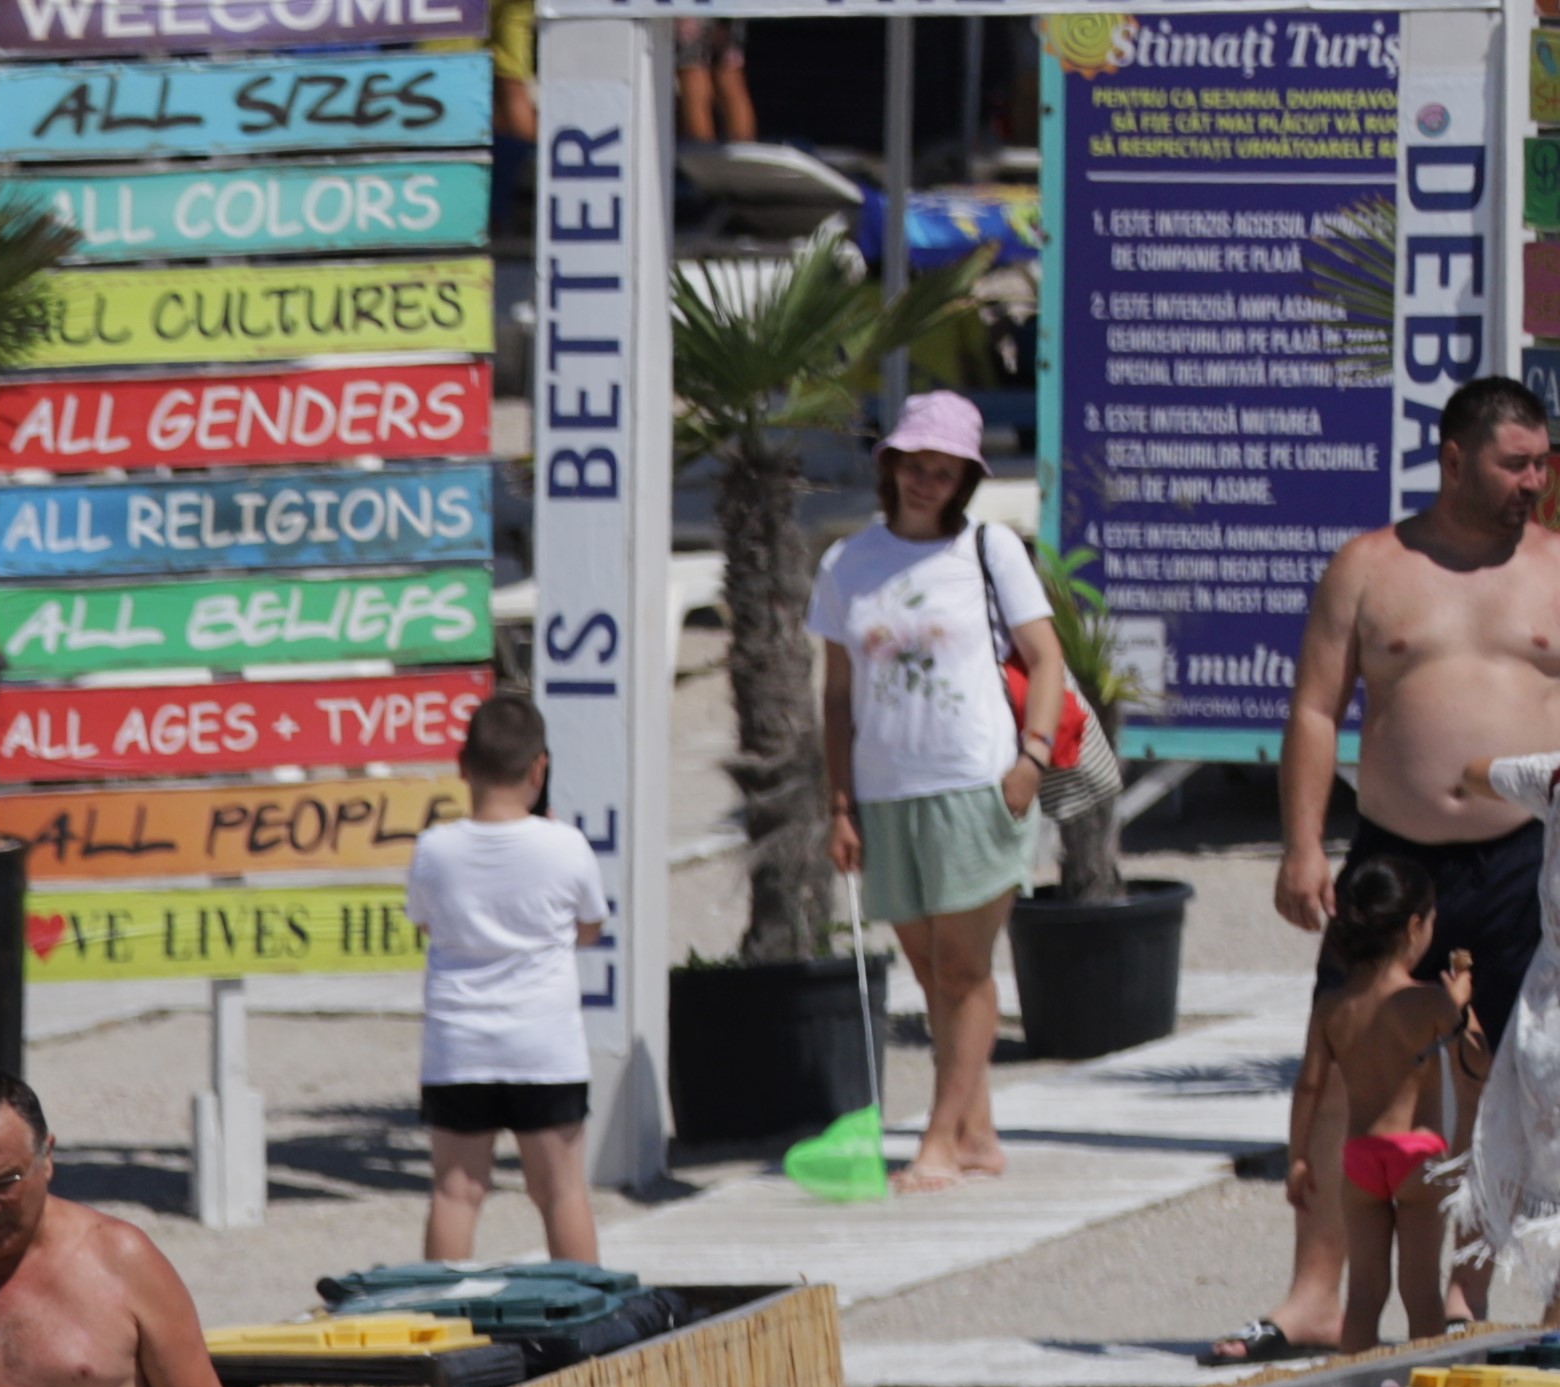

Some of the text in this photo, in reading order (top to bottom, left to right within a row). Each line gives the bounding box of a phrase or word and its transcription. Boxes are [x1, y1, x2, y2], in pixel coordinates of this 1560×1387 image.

[18, 0, 463, 41] WELCOME
[33, 71, 446, 138] ALL SIZES
[1091, 87, 1168, 109] PENTRU
[1170, 87, 1198, 109] CA
[1286, 88, 1398, 110] DUMNEAVO
[1215, 112, 1255, 133] MAI
[175, 174, 442, 240] COLORS
[1110, 210, 1154, 237] ESTE
[1156, 210, 1231, 237] INTERZIS
[1232, 211, 1310, 238] ACCESUL
[1137, 243, 1223, 272] COMPANIE
[1224, 244, 1250, 272] PE
[151, 281, 466, 342] CULTURES
[548, 123, 622, 500] BETTER
[1110, 291, 1152, 320] ESTE
[1153, 290, 1237, 321] INTERZISĂ
[1106, 357, 1172, 385] SPECIAL
[1174, 356, 1267, 386] DELIMITATĂ
[1269, 358, 1334, 387] PENTRU
[11, 380, 466, 455] ALL GENDERS
[1105, 403, 1149, 434] ESTE
[1150, 402, 1238, 435] INTERZISĂ
[1239, 406, 1323, 436] MUTAREA
[1243, 442, 1269, 470] DE
[1271, 443, 1294, 470] PE
[1295, 442, 1379, 472] LOCURILE
[3, 486, 474, 553] ALL RELIGIONS
[1104, 521, 1144, 548] ESTE
[1145, 519, 1223, 550] INTERZISĂ
[5, 582, 477, 656] ALL BELIEFS
[1214, 586, 1263, 613] ACEST
[546, 611, 620, 696] IS
[0, 690, 481, 760] ALL AGES + TYPES
[26, 804, 177, 861] ALL
[162, 903, 313, 962] LIVES
